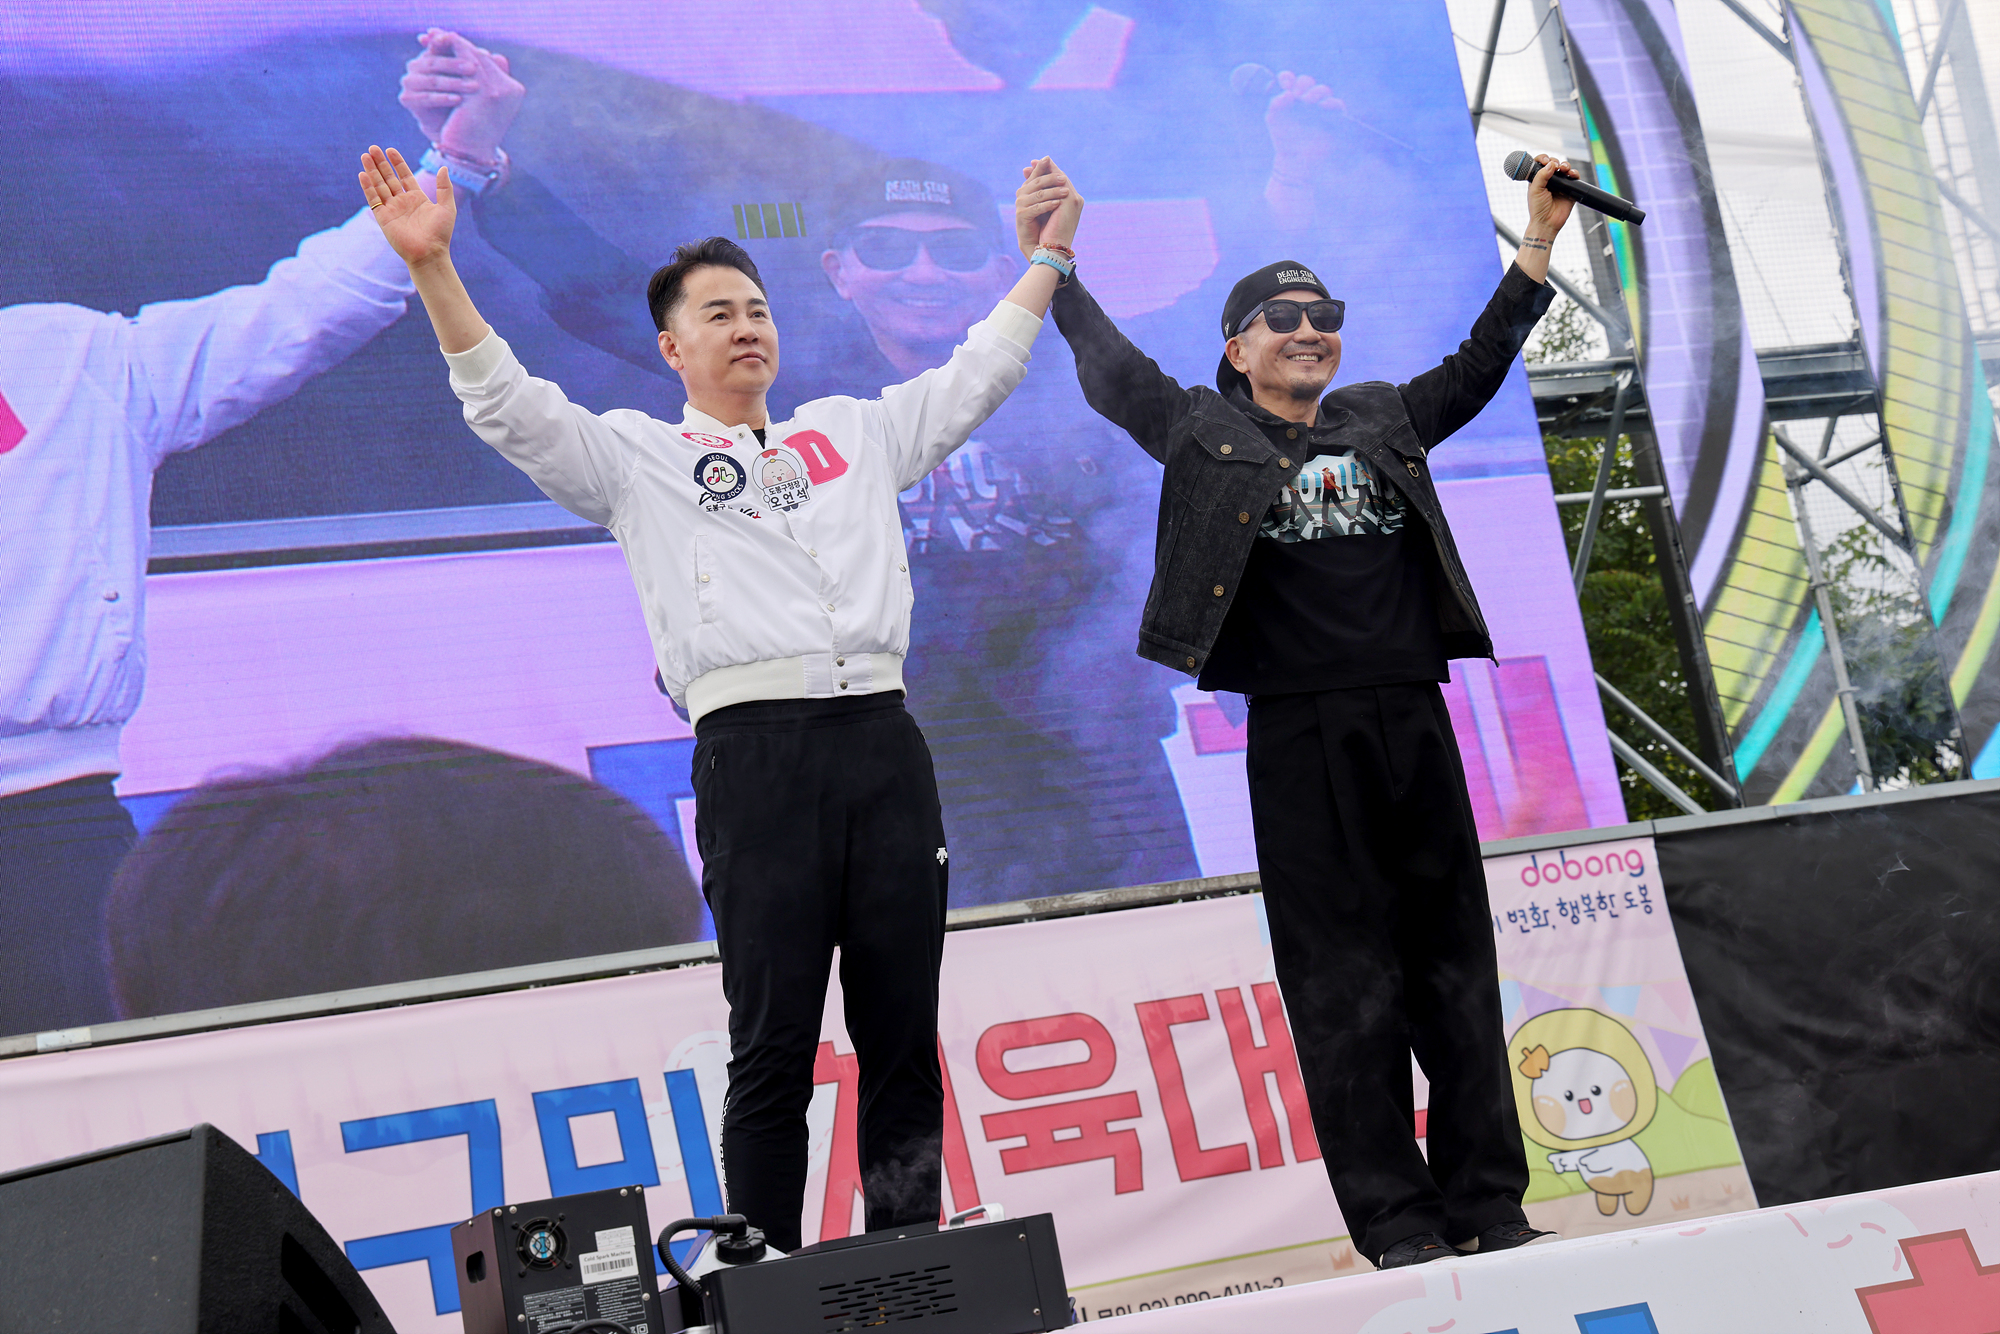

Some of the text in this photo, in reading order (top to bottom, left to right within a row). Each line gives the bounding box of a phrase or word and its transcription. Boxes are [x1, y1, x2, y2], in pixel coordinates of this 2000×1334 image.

[1276, 269, 1299, 279] DEATH
[707, 454, 729, 462] SEOUL
[782, 429, 849, 486] D
[727, 483, 744, 498] SOCKS
[769, 480, 801, 495] 도봉구청장
[1521, 849, 1645, 887] dobong
[1556, 890, 1619, 926] 행복한
[1623, 883, 1654, 915] 도봉
[596, 1253, 610, 1261] Spark
